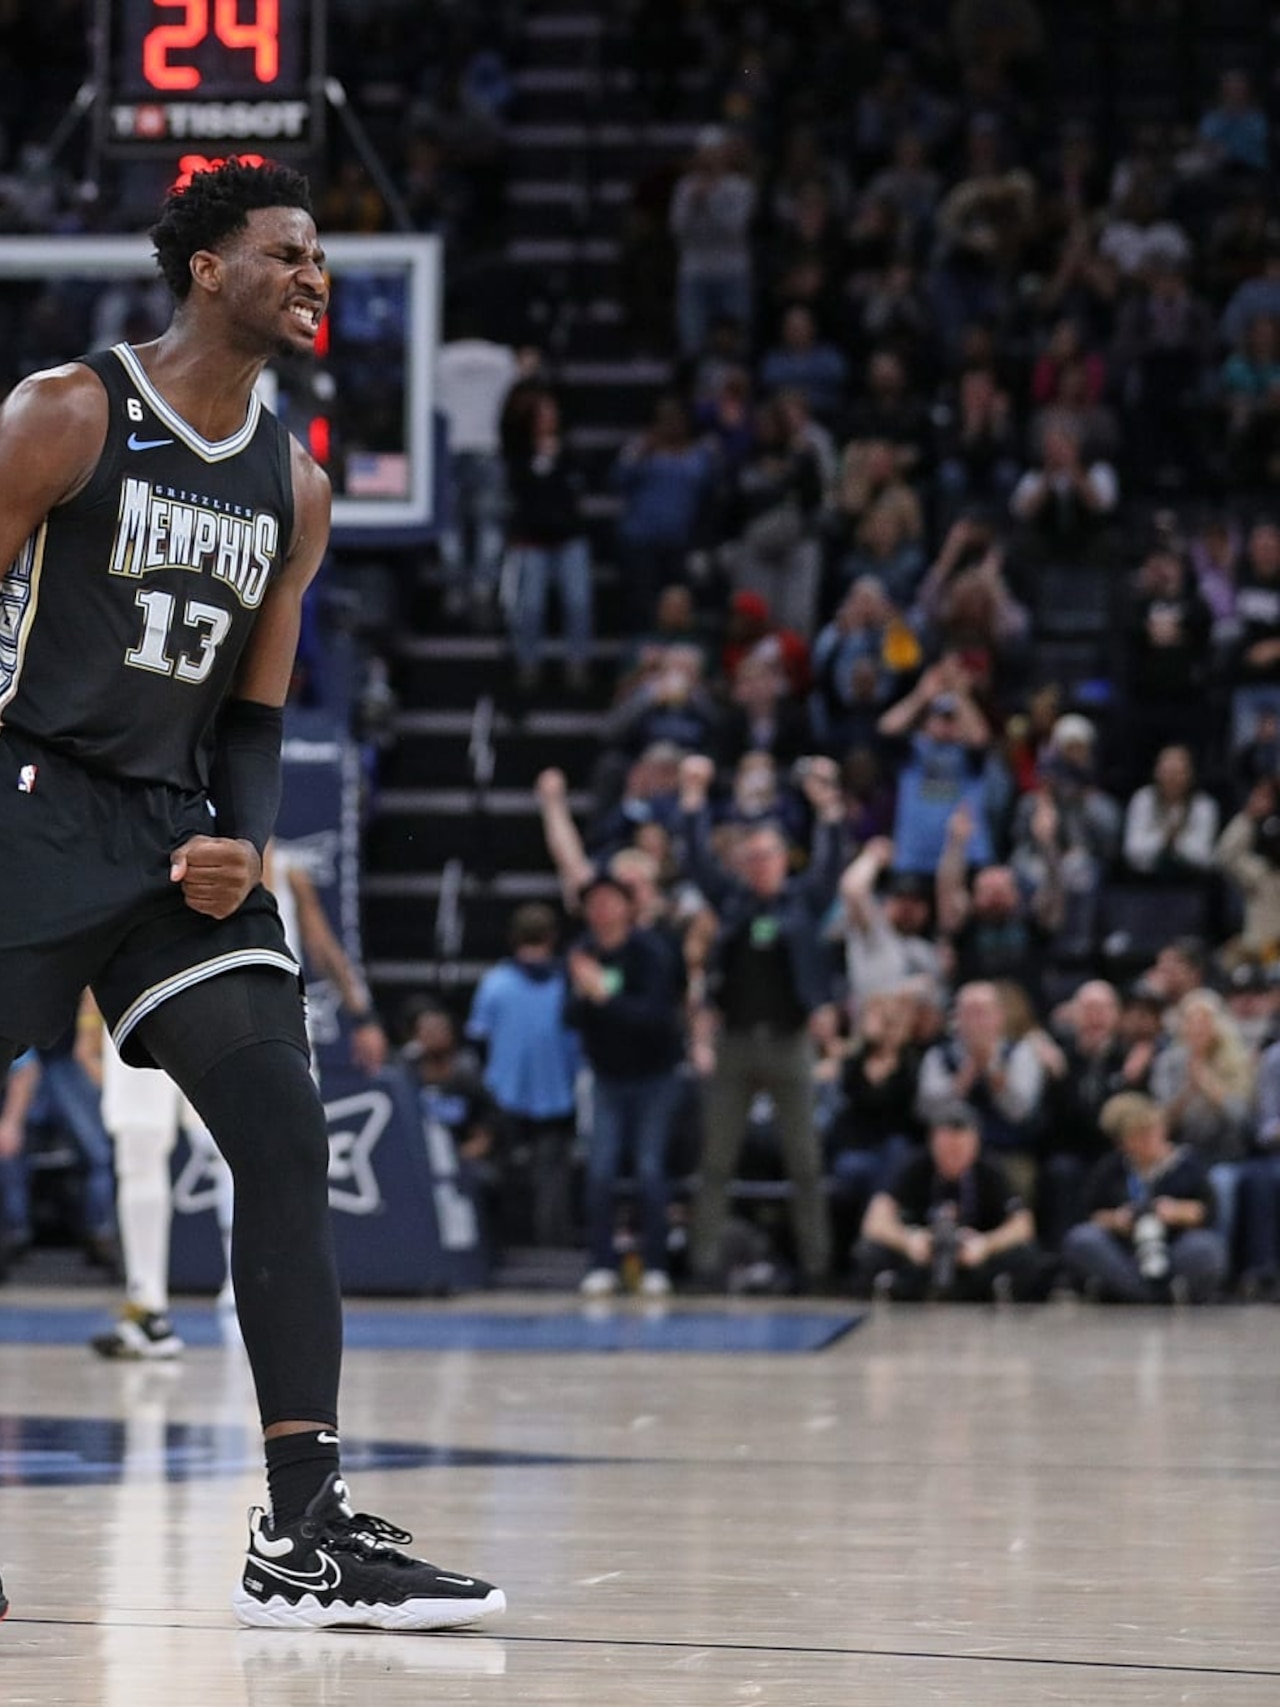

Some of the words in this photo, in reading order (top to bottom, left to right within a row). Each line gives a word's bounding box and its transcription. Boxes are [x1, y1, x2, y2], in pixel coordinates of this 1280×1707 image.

[143, 0, 279, 90] 24
[126, 398, 144, 422] 6
[108, 476, 279, 610] MEMPHIS
[154, 484, 254, 518] GRIZZLIES
[124, 588, 232, 685] 13
